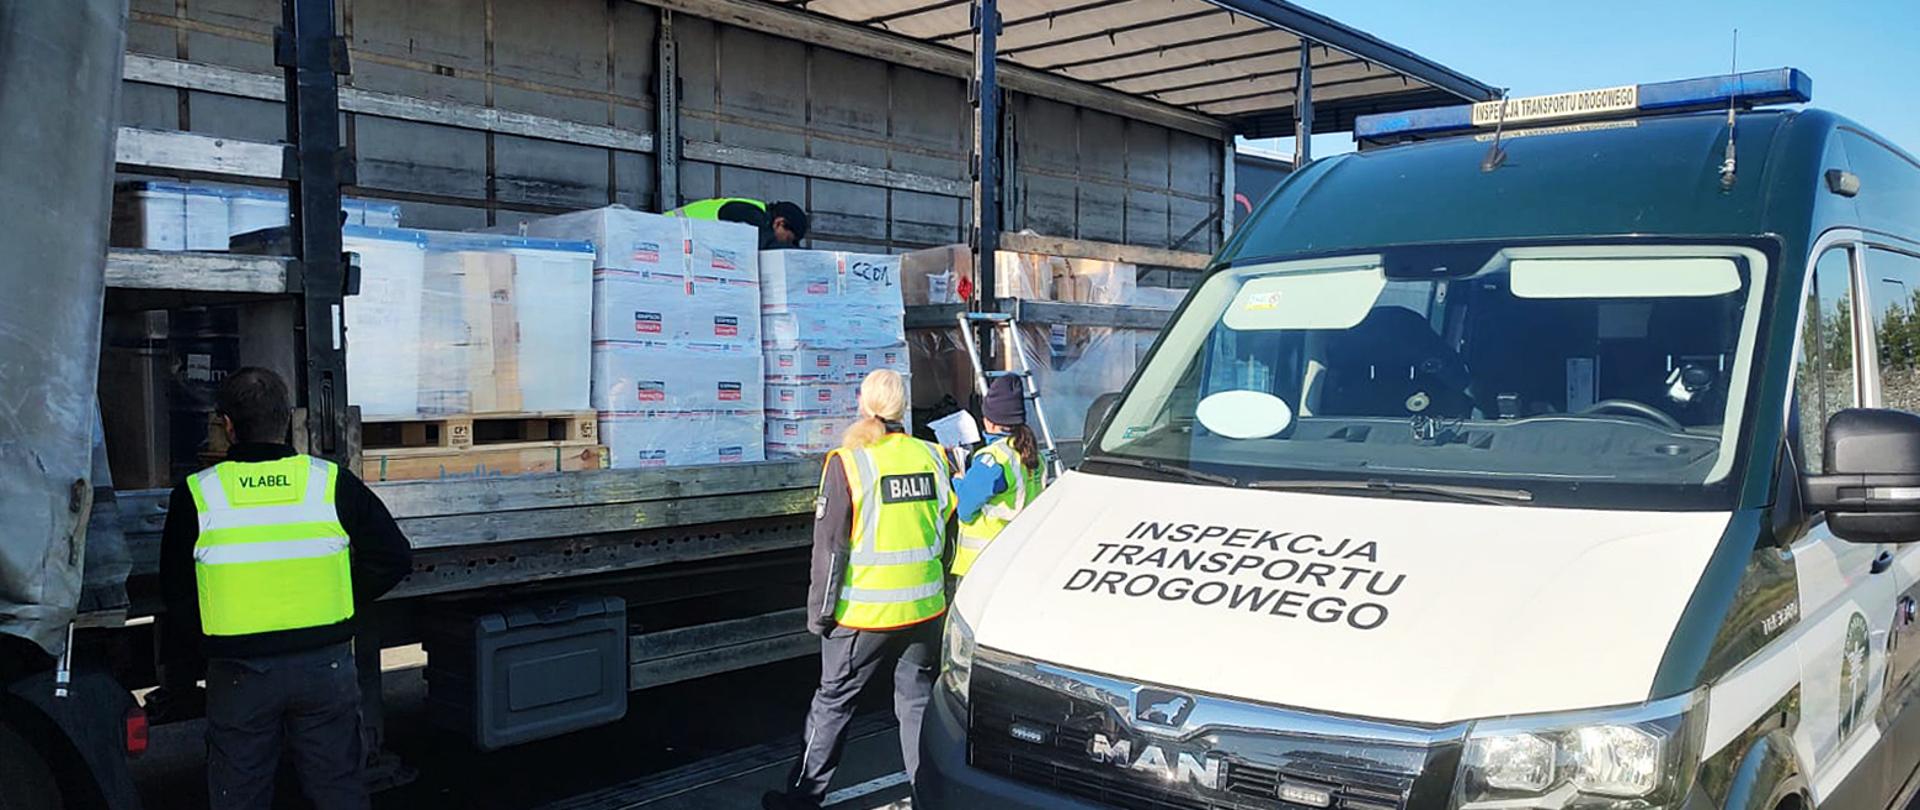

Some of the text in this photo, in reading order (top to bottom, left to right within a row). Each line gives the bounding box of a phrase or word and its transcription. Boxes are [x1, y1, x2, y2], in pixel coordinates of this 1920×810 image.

[1476, 88, 1634, 121] INSPECJA TRANSPORTU DROGOWEGO
[239, 474, 291, 488] VLABEL
[889, 475, 931, 499] BALM
[1125, 521, 1378, 563] INSPEKCJA
[1090, 543, 1407, 596] TRANSPORTU
[1063, 568, 1389, 630] DROGOWEGO
[1090, 733, 1222, 790] MAN
